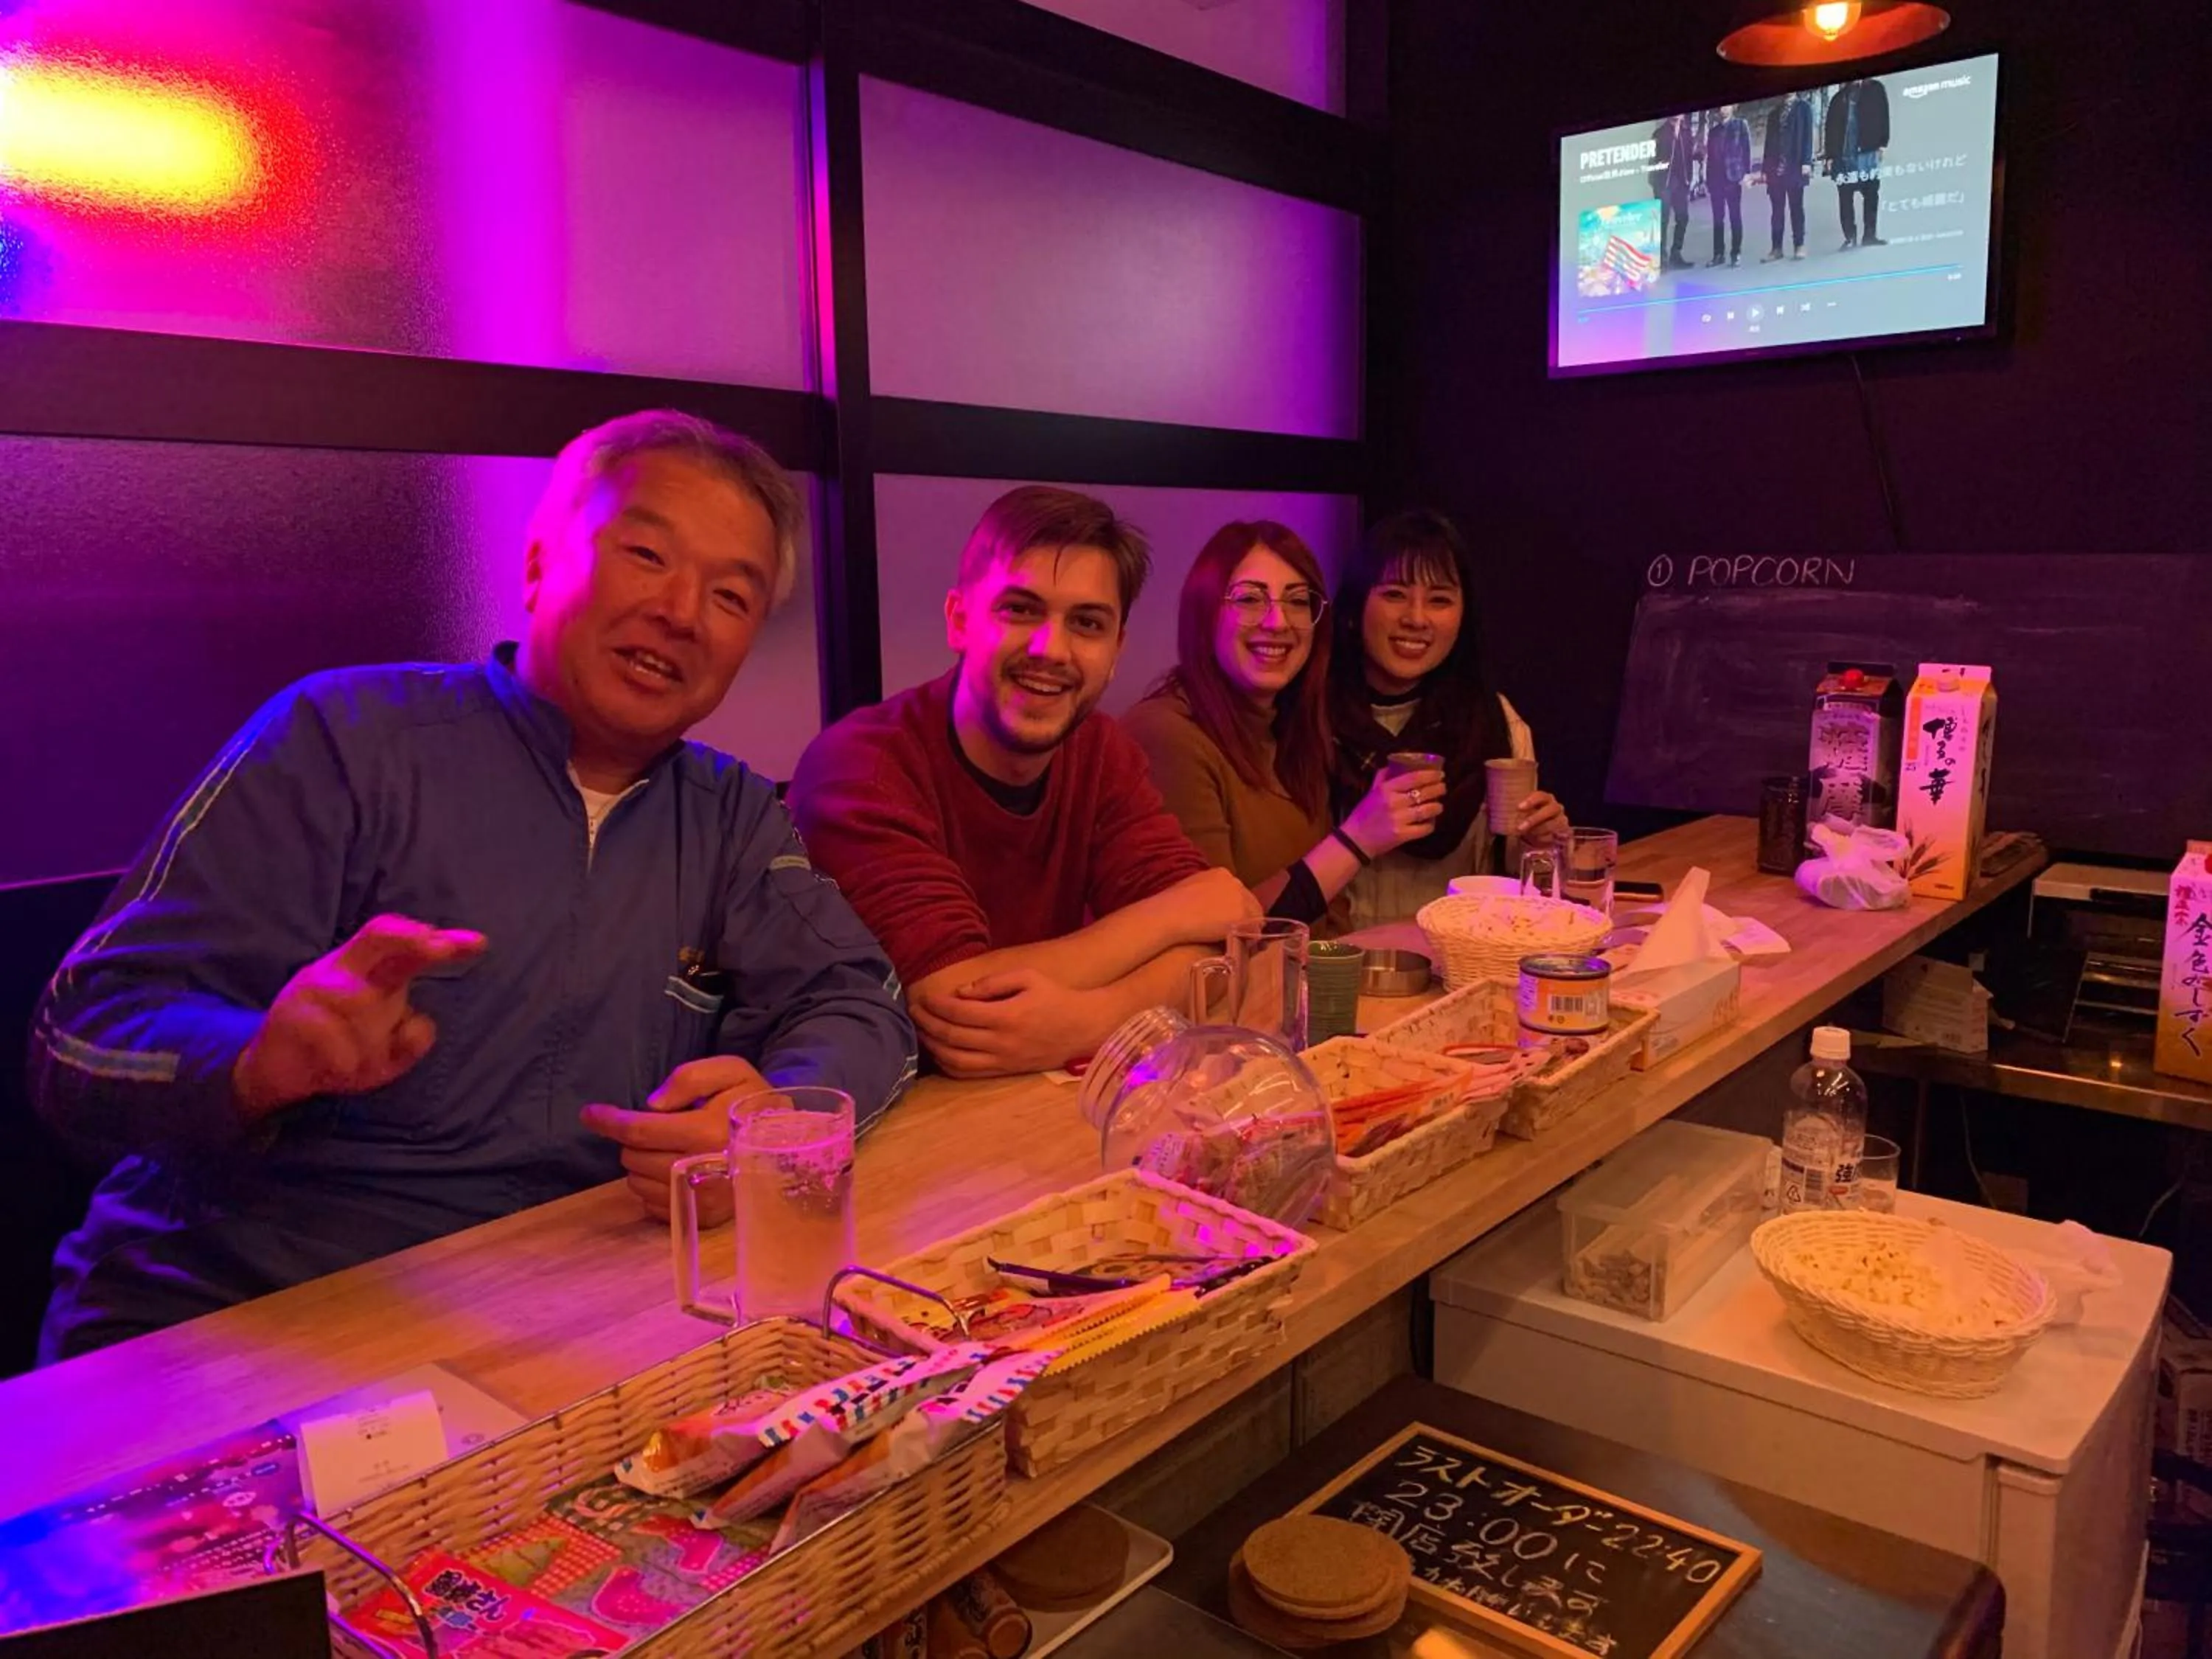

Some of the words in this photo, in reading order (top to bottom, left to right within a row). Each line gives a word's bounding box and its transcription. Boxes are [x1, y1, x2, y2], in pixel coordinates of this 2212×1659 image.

[1941, 74, 1971, 89] music
[1580, 140, 1656, 170] PRETENDER
[1688, 554, 1854, 586] POPCORN
